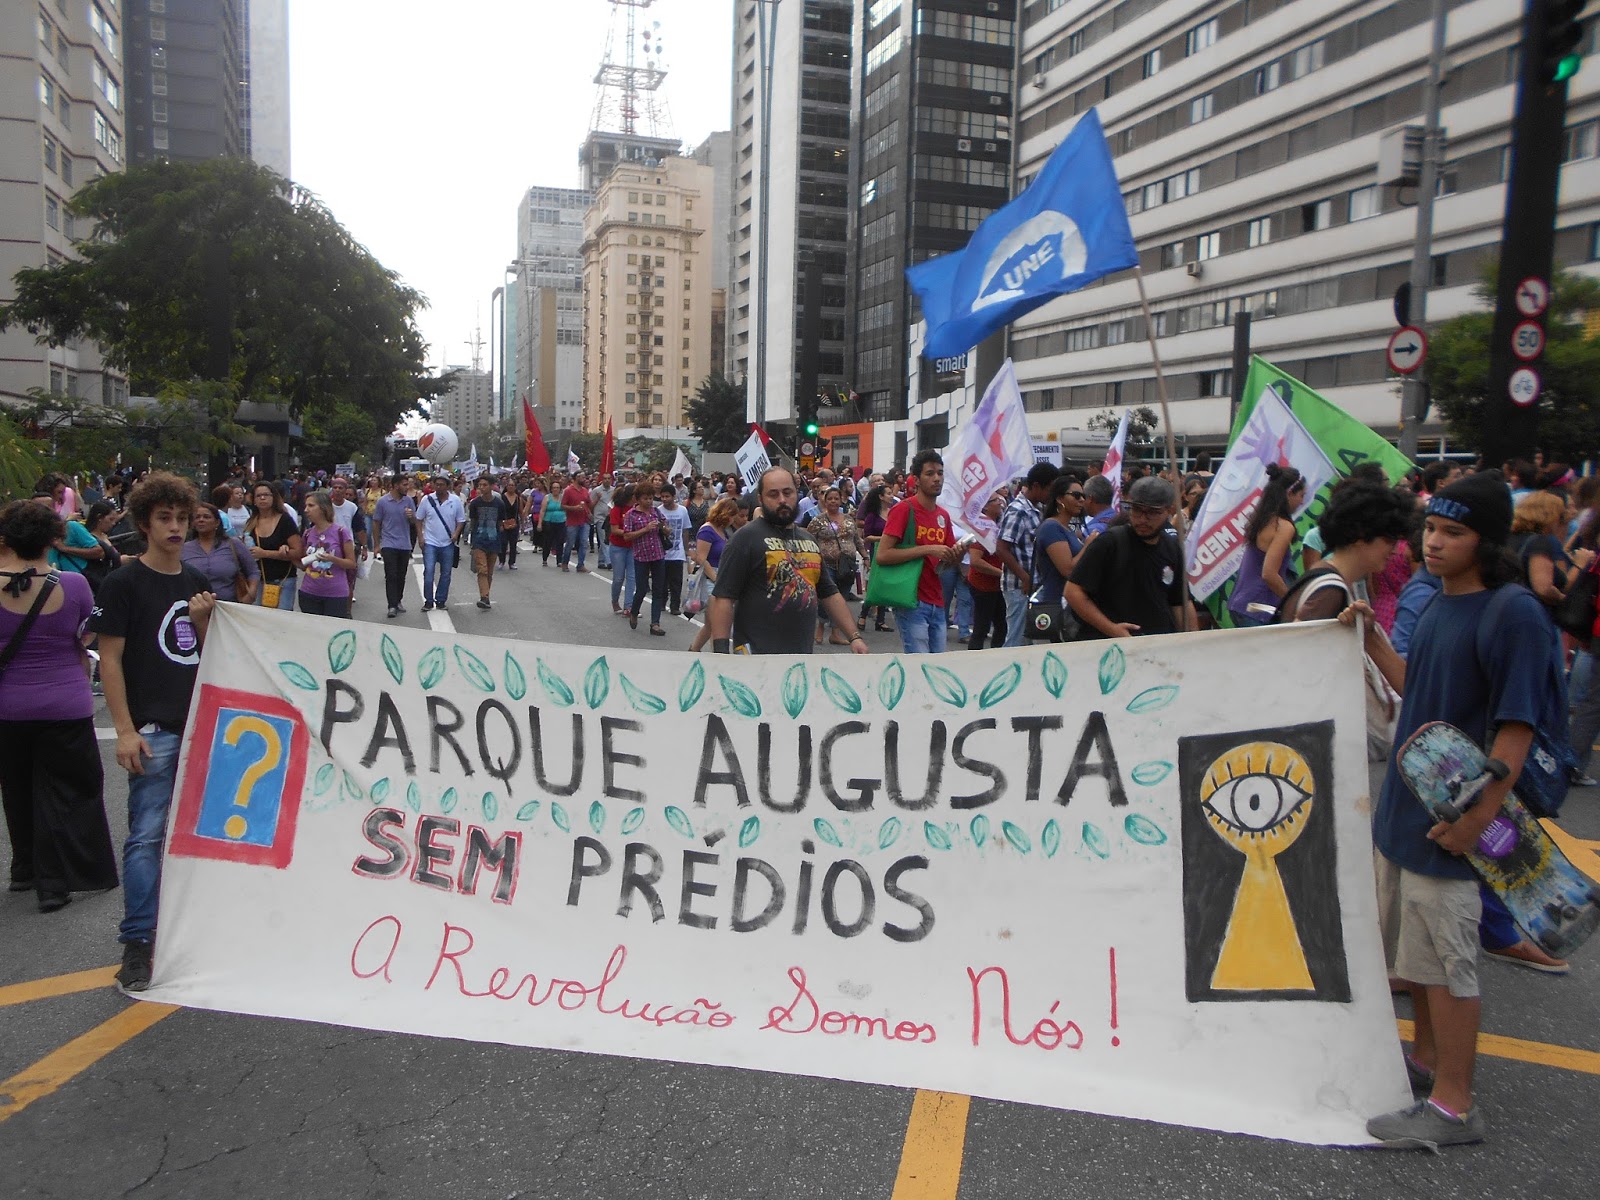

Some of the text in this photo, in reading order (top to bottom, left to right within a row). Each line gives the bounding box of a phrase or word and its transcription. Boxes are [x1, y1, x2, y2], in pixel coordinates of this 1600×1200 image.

[1003, 240, 1056, 290] UNE
[936, 353, 966, 373] smart
[1518, 330, 1538, 347] 50
[320, 678, 1129, 813] PARQUE AUGUSTA
[351, 807, 522, 906] SEM
[425, 922, 735, 1028] Revolução
[759, 966, 937, 1044] Somos
